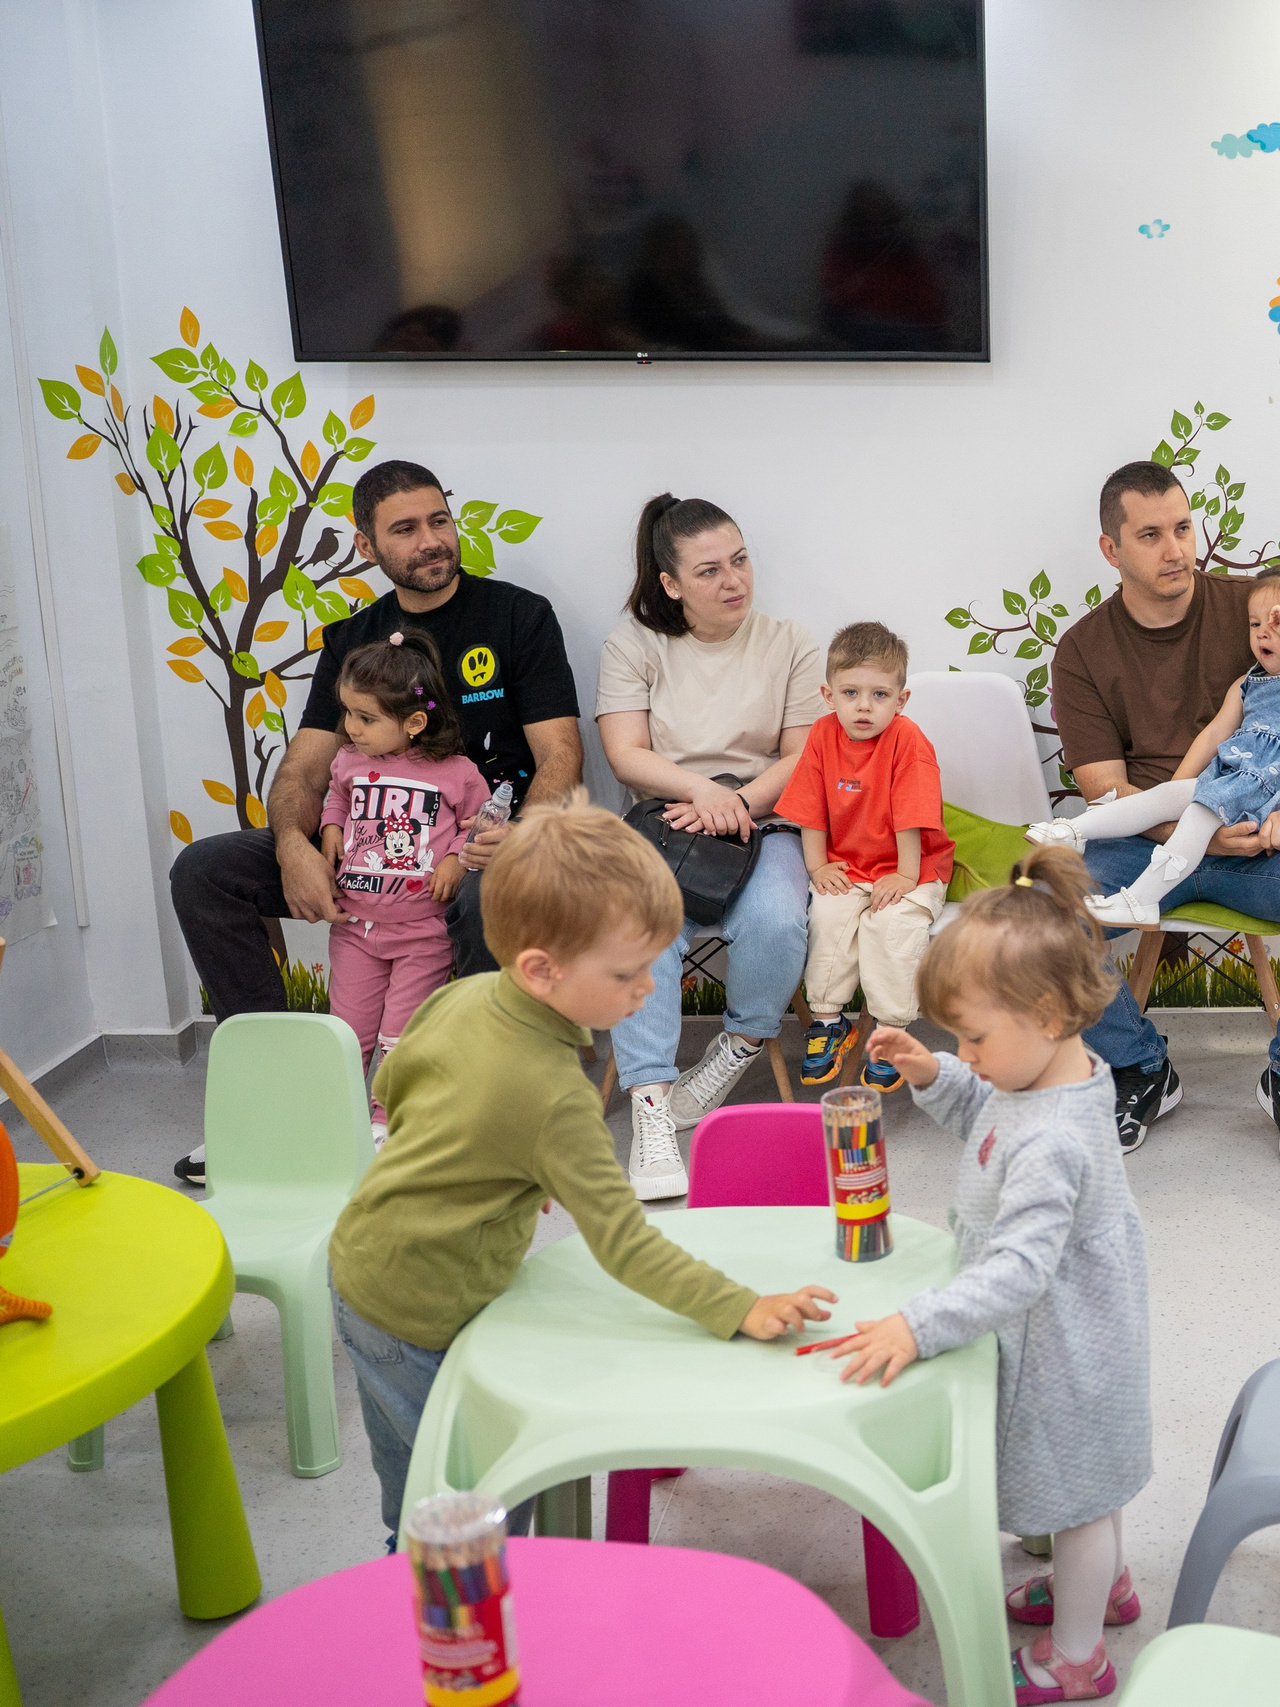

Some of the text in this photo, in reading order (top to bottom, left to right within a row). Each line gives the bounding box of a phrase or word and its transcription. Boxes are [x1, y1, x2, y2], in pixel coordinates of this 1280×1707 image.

[461, 688, 504, 704] BARROW
[350, 787, 430, 824] GIRL
[428, 794, 439, 826] LOVE
